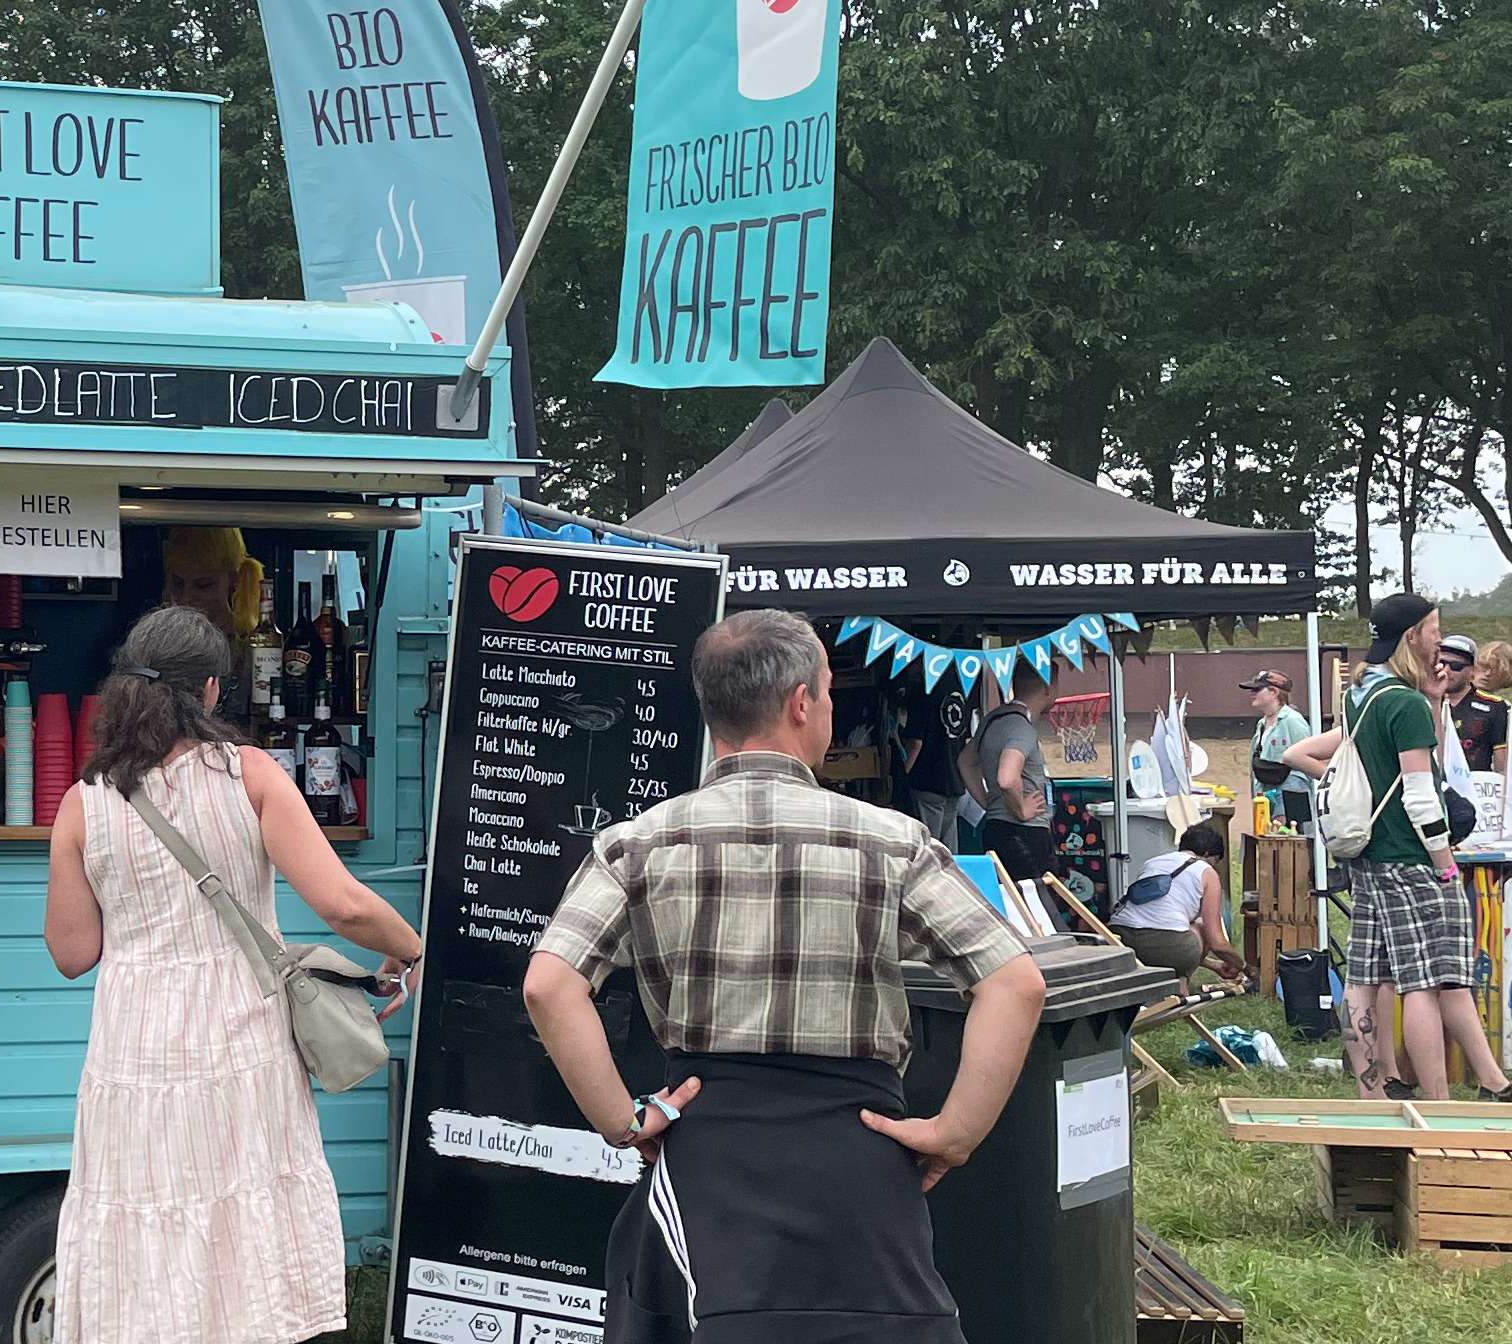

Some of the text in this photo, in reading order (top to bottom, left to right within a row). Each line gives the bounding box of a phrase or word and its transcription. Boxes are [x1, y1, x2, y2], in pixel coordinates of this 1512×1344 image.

[327, 8, 404, 70] BIO
[308, 81, 454, 147] KAFFEE
[25, 112, 144, 182] LOVE
[644, 112, 831, 214] FRISCHER BIO
[631, 208, 827, 365] KAFFEE
[20, 494, 72, 515] HIER
[784, 566, 908, 590] WASSER
[1009, 557, 1288, 587] WASSER FÜR ALLE
[569, 570, 679, 604] FIRST LOVE
[584, 602, 657, 633] COFFEE
[481, 635, 675, 665] KAFFEE-CATERING MIT STIL
[928, 653, 1011, 679] CON
[1035, 613, 1120, 671] AGU
[481, 662, 514, 682] Latte
[518, 665, 576, 688] Macchiato
[479, 687, 540, 709] Cappuccino
[477, 711, 538, 733] Filterkaffee
[475, 734, 499, 753] Flat
[504, 737, 536, 757] White
[473, 759, 565, 786] Espresso/Doppio
[470, 783, 527, 805] Americano
[468, 806, 525, 828] Mocaccino
[466, 830, 561, 856] Heiße Schokolade
[464, 854, 521, 876] Chai Latte
[463, 877, 479, 895] Tee
[443, 1123, 472, 1146] Iced
[479, 1129, 553, 1158] Latte/Chai
[459, 1244, 587, 1276] Allergene bitte erfragen
[557, 1293, 591, 1310] VISA
